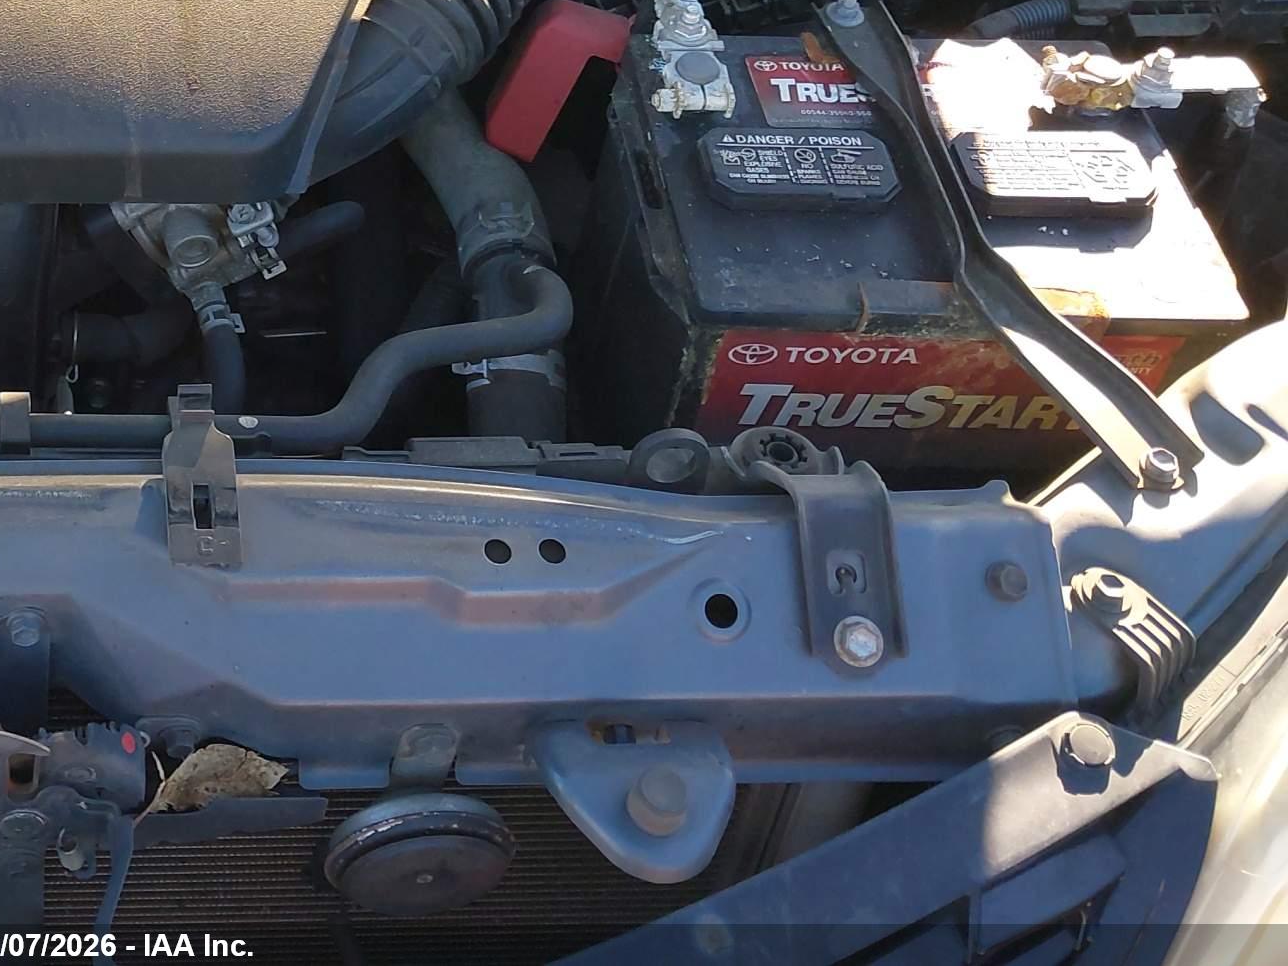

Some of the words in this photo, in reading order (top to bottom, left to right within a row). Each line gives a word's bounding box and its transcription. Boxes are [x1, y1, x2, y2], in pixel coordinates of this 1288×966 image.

[779, 60, 845, 72] TOYOTA
[735, 134, 795, 145] DANGER
[798, 135, 805, 145] /
[809, 136, 862, 146] POISON
[785, 346, 918, 365] TOYOTA
[737, 383, 1081, 431] TRUESTAR
